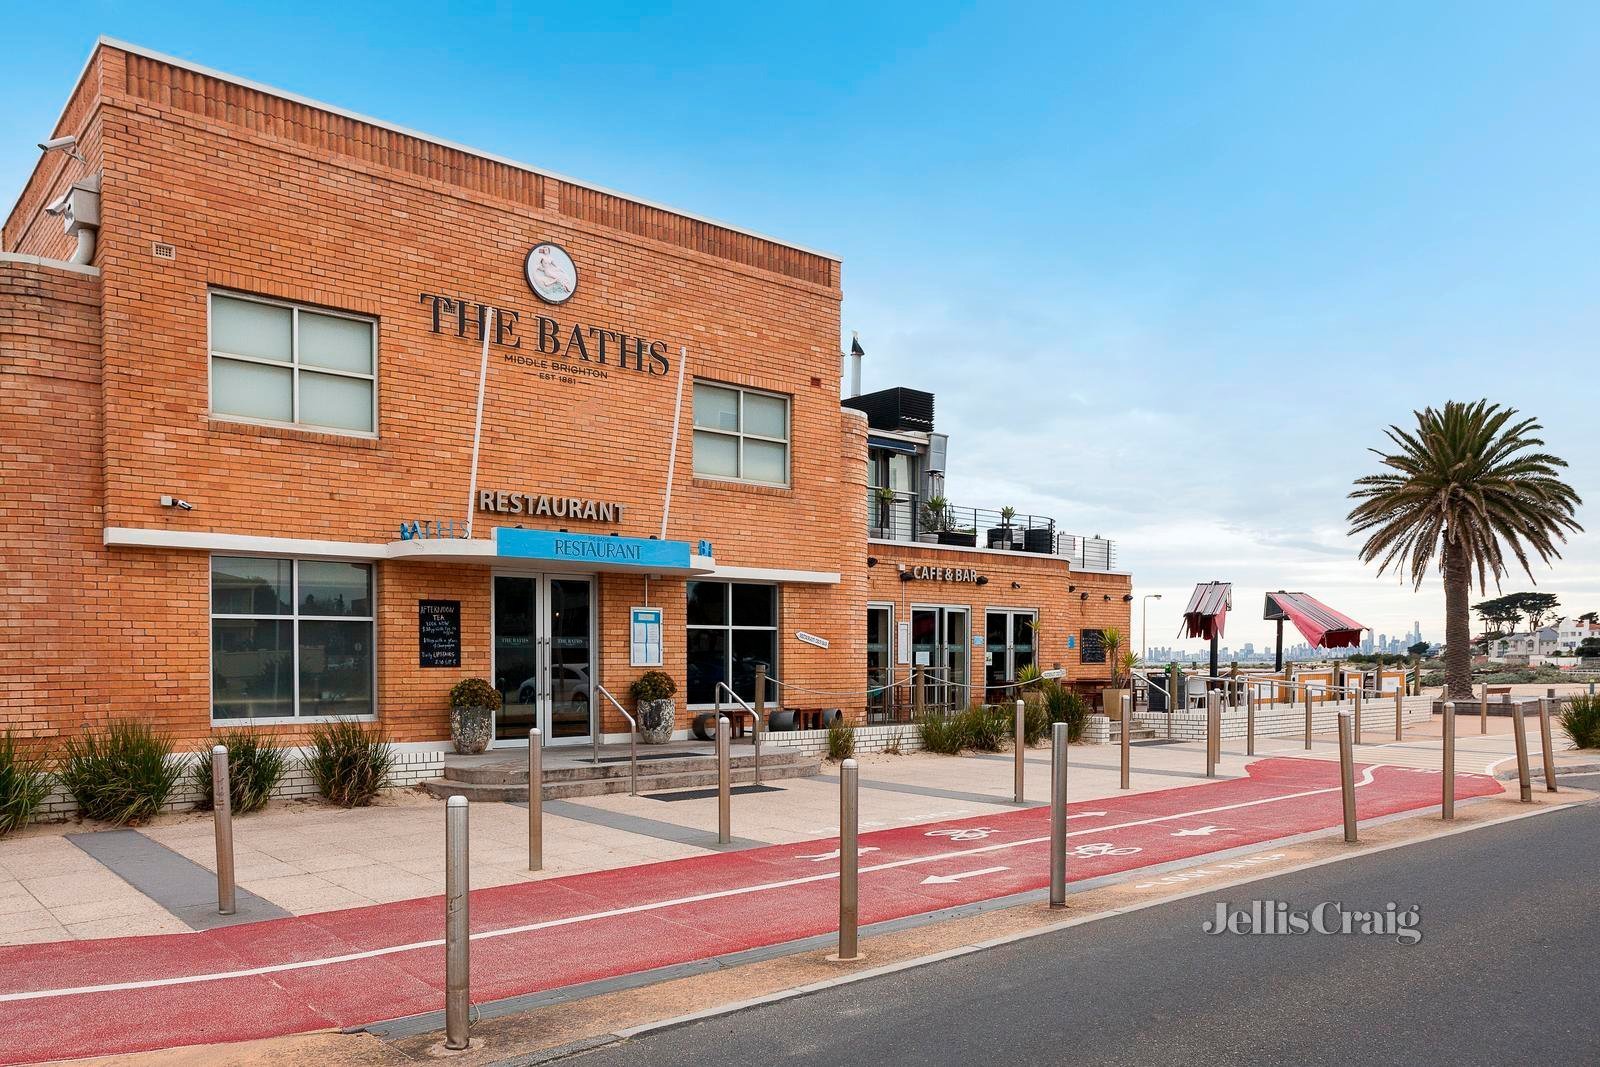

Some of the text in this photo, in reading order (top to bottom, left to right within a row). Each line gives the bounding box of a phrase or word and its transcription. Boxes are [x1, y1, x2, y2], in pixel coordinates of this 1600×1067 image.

[420, 292, 670, 376] THE BATHS
[504, 353, 608, 379] MIDDLE BRIGHTON
[539, 372, 577, 385] EST 1881
[479, 489, 626, 523] RESTAURANT
[400, 518, 470, 540] BATHS
[555, 539, 642, 560] RESTAURANT
[913, 565, 977, 583] CAFE & BAR
